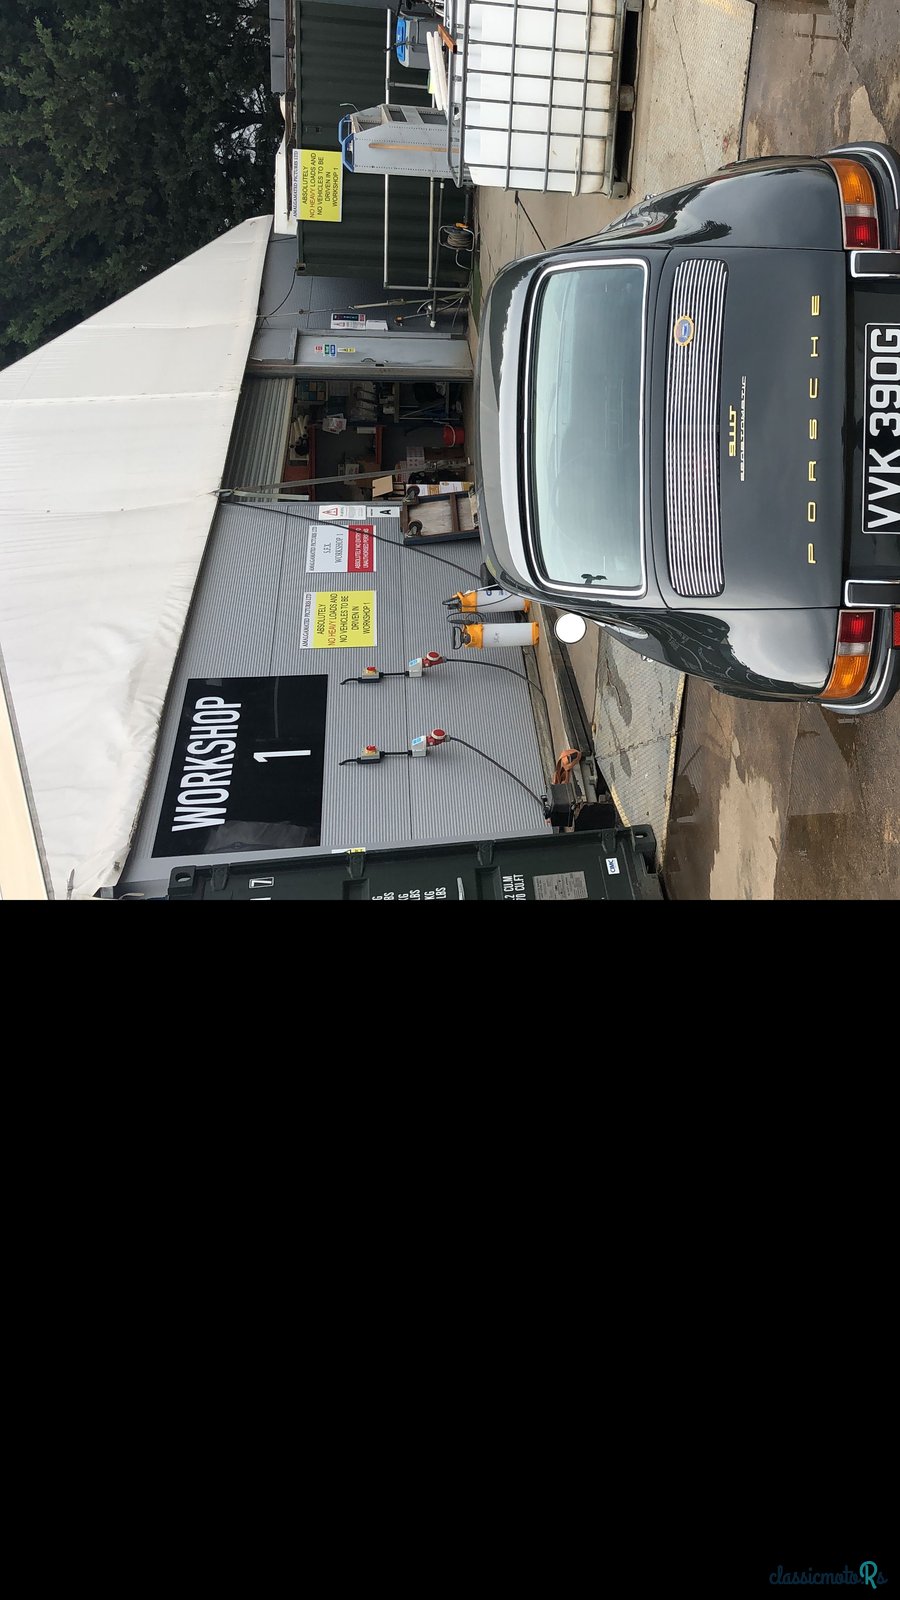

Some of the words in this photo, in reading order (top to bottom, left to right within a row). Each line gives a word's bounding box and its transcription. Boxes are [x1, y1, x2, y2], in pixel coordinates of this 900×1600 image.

[318, 157, 324, 165] BE
[318, 166, 324, 174] TO
[310, 209, 315, 218] NO
[317, 206, 322, 216] NO
[870, 328, 900, 437] 390G
[808, 295, 820, 564] PORSCHE
[868, 448, 900, 528] VVK
[334, 538, 343, 563] WORKSHOP
[316, 604, 326, 634] ABSOLUTELY
[329, 604, 337, 620] LOADS
[328, 620, 336, 636] HEAVY
[340, 610, 348, 634] VEHICLES
[351, 612, 359, 630] DRIVEN
[172, 696, 242, 832] WORKSHOP
[253, 750, 312, 763] 1
[502, 876, 514, 892] CU.M
[513, 874, 525, 891] CU.FT
[436, 887, 446, 899] LBS
